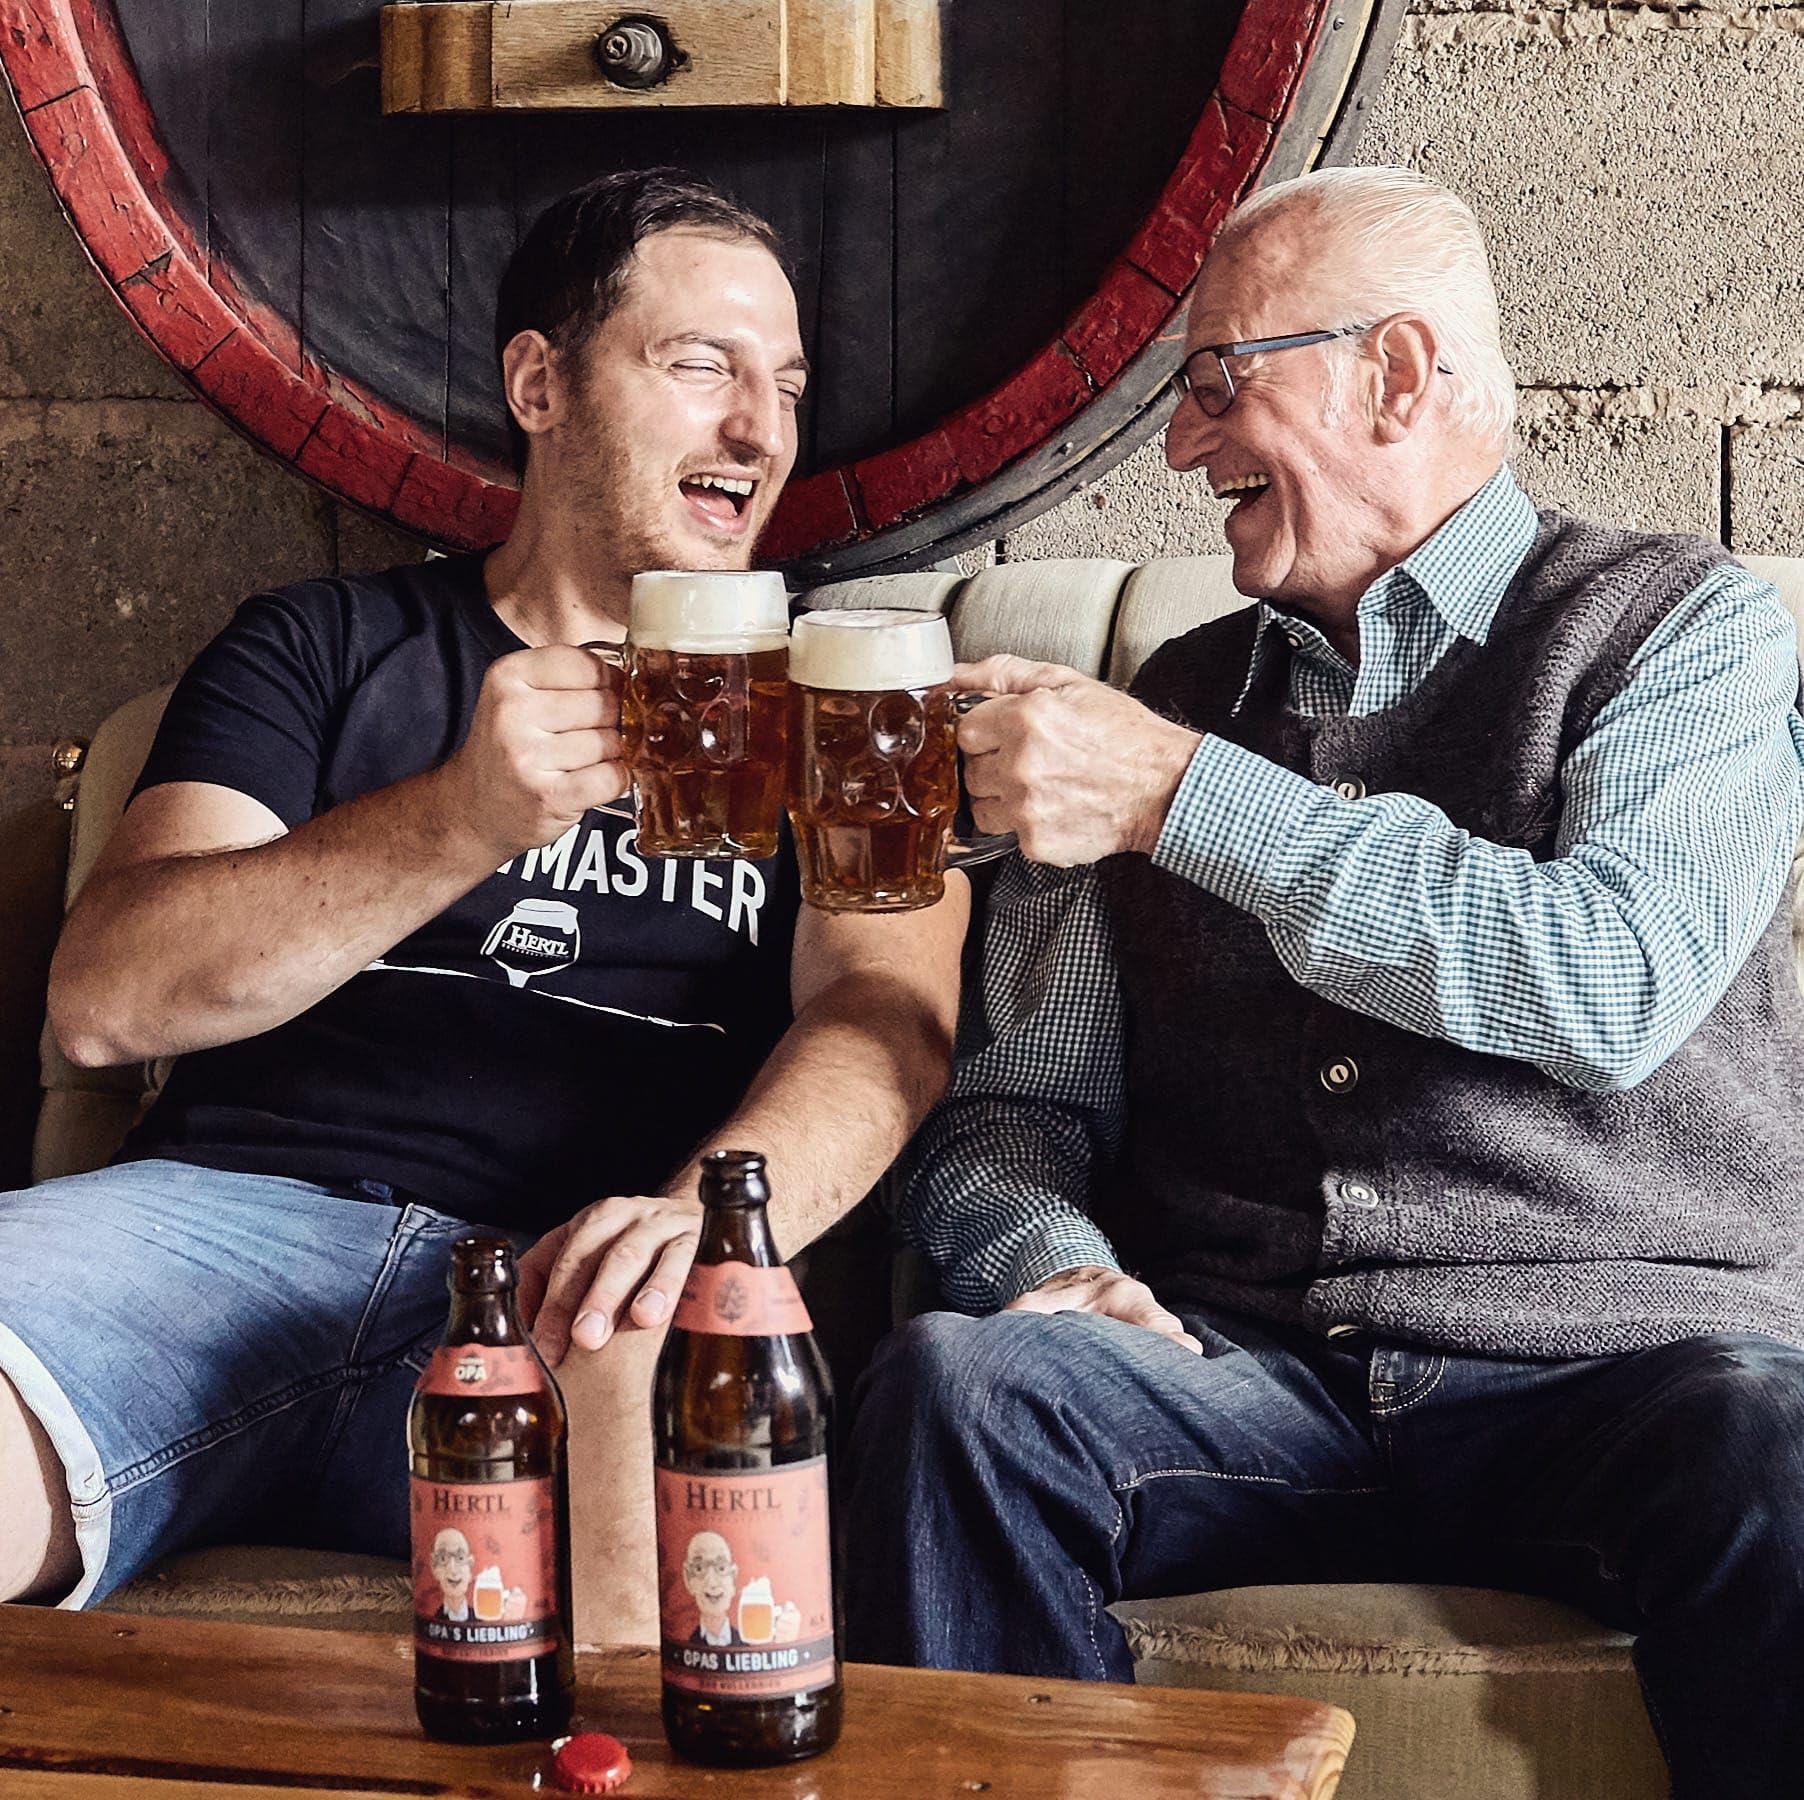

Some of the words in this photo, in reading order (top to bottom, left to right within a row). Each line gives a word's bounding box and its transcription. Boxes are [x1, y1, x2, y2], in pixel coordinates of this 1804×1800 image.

[497, 823, 766, 947] MASTER
[503, 925, 569, 956] HERTL
[455, 1365, 487, 1381] OPA
[432, 1488, 511, 1513] HERTL
[686, 1482, 781, 1511] HERTL
[466, 1624, 528, 1643] LIEBLING
[683, 1649, 719, 1670] OPAS
[725, 1649, 799, 1672] LIEBLING
